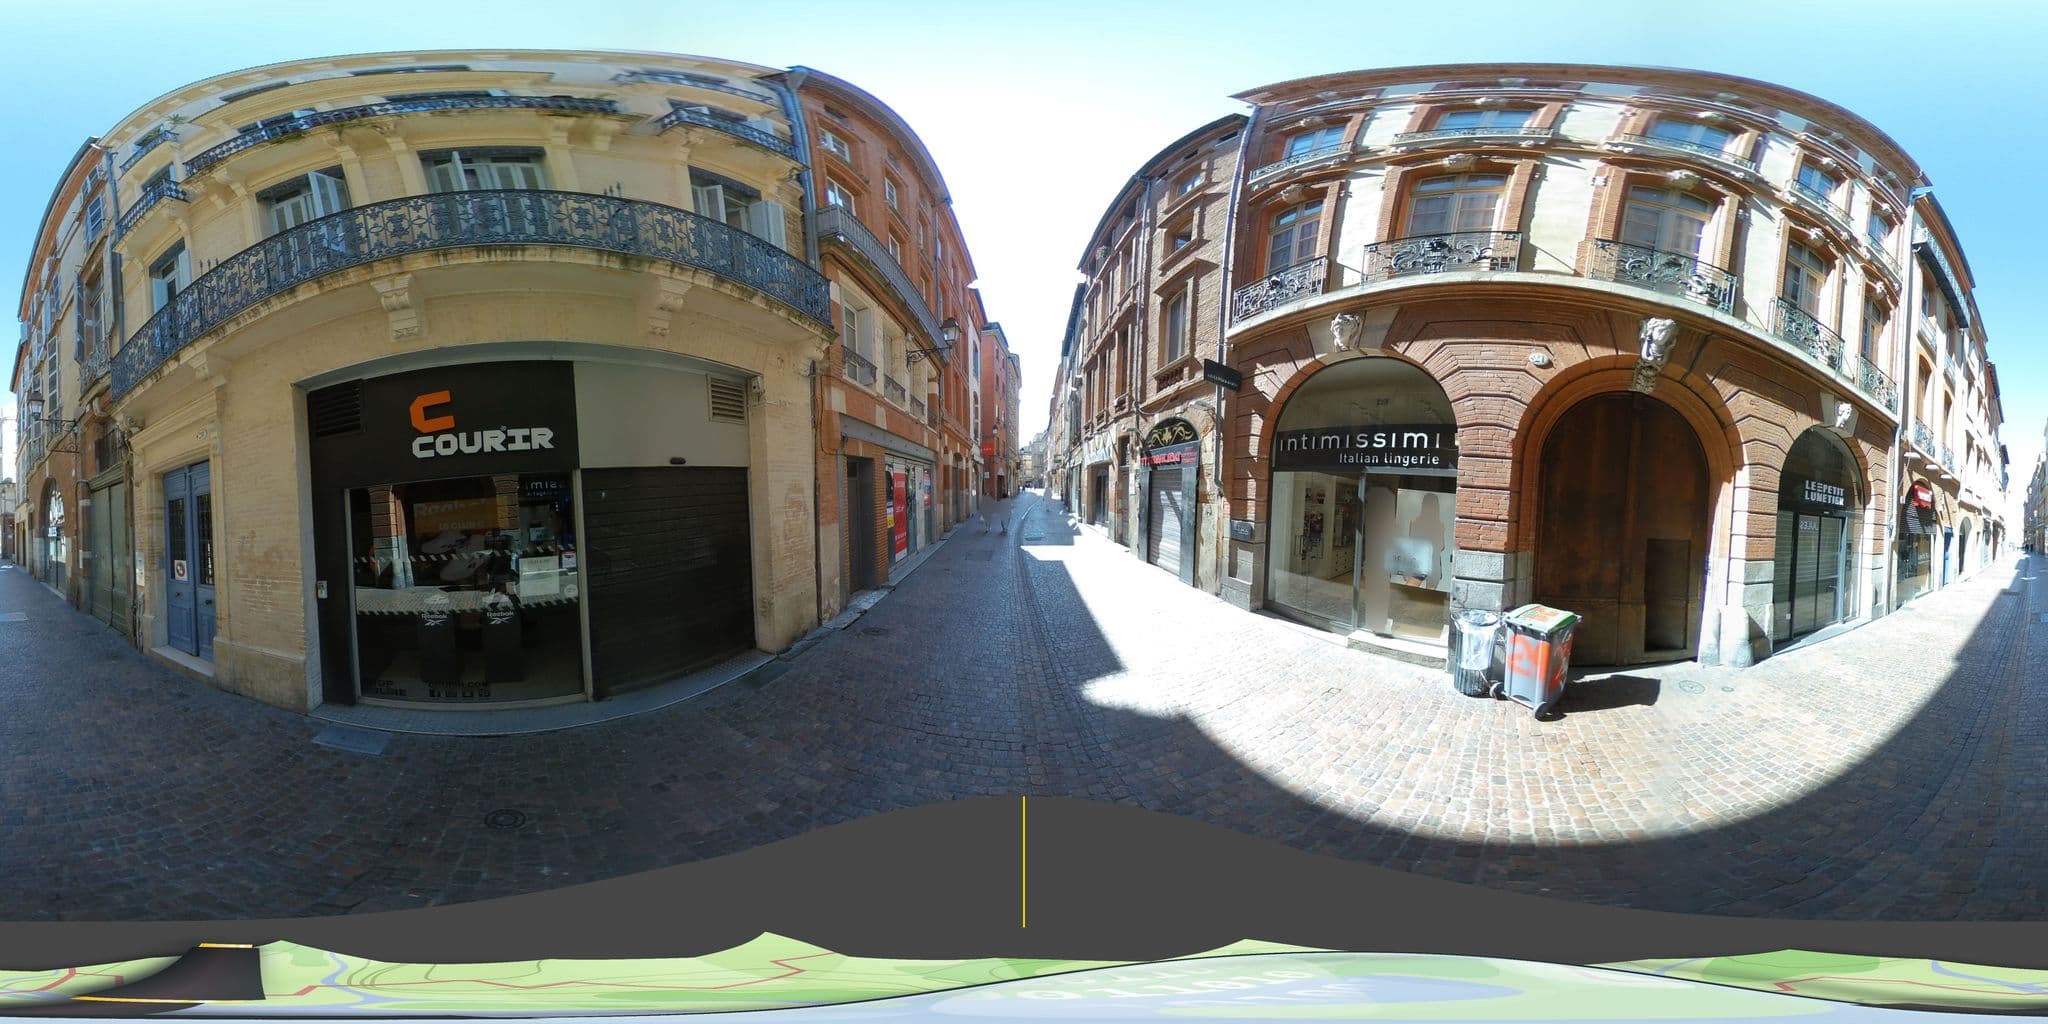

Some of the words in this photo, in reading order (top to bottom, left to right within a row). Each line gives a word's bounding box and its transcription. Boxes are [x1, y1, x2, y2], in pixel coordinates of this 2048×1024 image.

[410, 390, 455, 434] C
[412, 427, 554, 459] COURIR
[1279, 432, 1441, 452] intimissimi
[1339, 453, 1379, 464] Italian
[1384, 453, 1440, 467] lingerie
[1805, 480, 1817, 491] LE
[1823, 484, 1845, 497] PETIT
